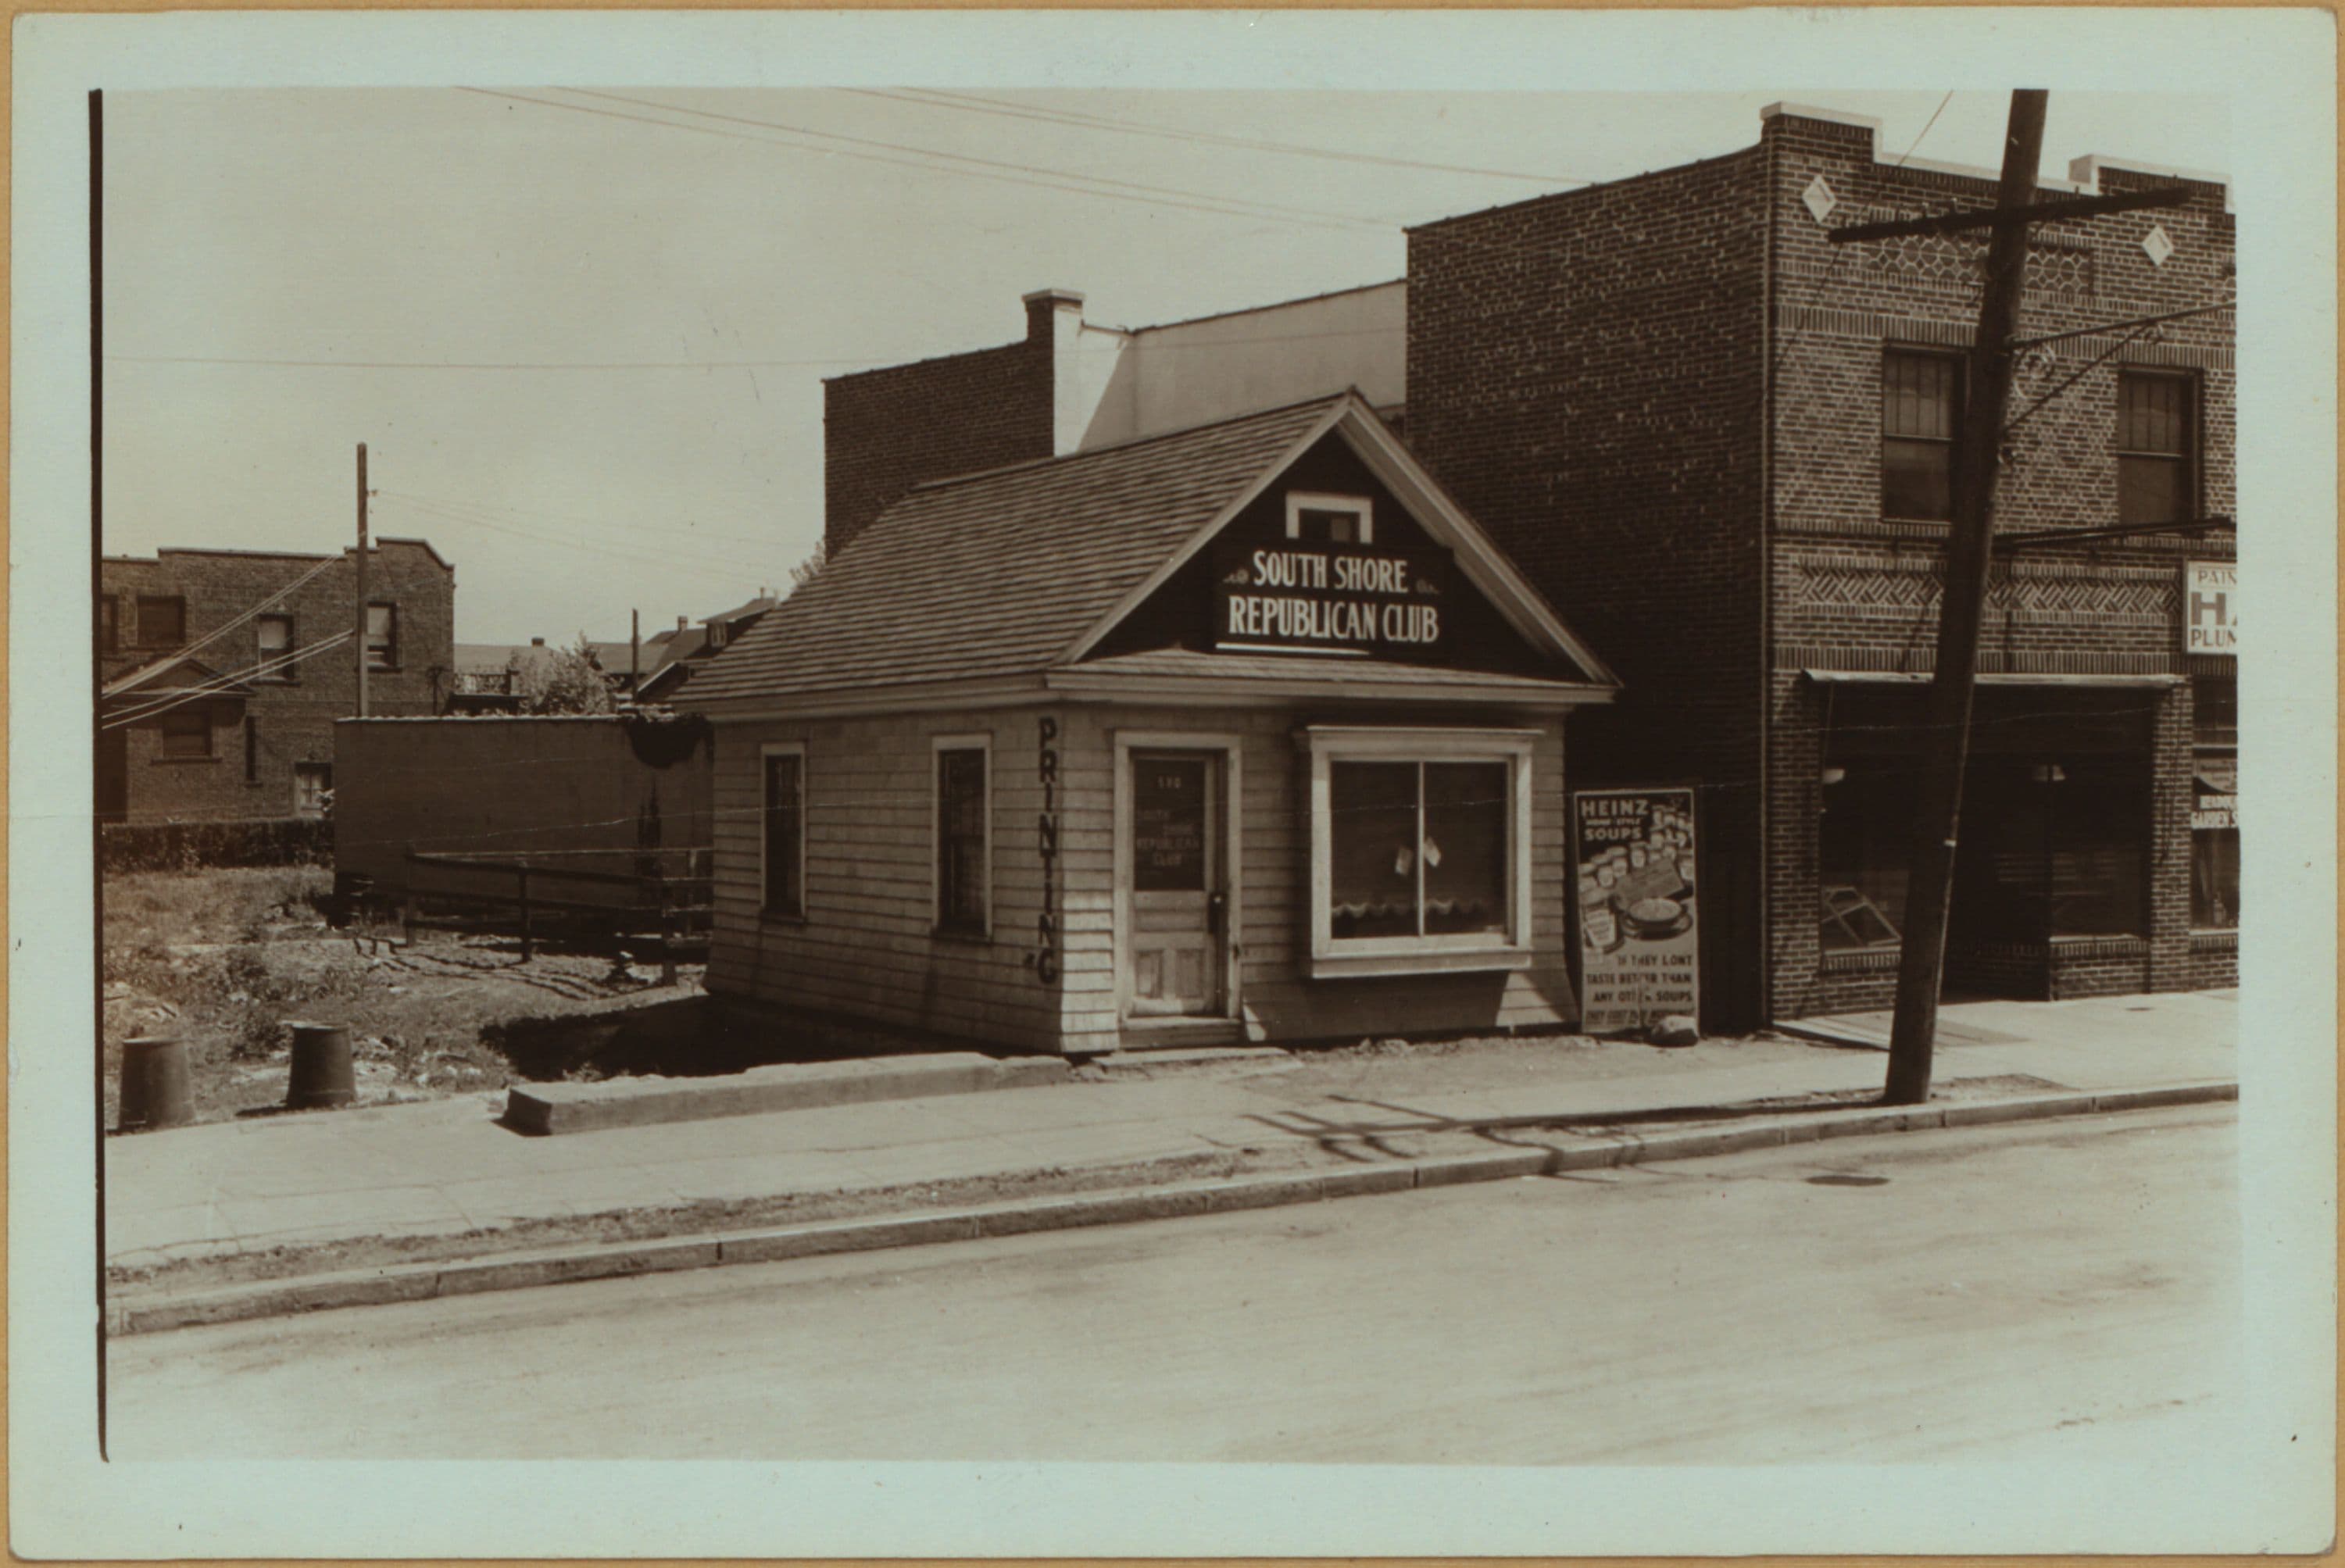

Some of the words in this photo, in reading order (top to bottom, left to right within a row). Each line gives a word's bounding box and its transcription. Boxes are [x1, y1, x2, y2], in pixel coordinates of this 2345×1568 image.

[1253, 550, 1328, 588] SOUTH
[1334, 555, 1408, 594] SHORE
[2190, 591, 2237, 627] H
[1228, 595, 1377, 641] REPUBLICAN
[1382, 603, 1439, 643] CLUB
[1581, 799, 1649, 817] HEINZ
[1584, 827, 1642, 841] SOUPS
[1038, 716, 1057, 984] PRINTING
[1631, 954, 1657, 966] THEY
[1661, 972, 1692, 984] THAN
[1593, 991, 1614, 1002] ANY
[1656, 990, 1693, 1002] SOUPS
